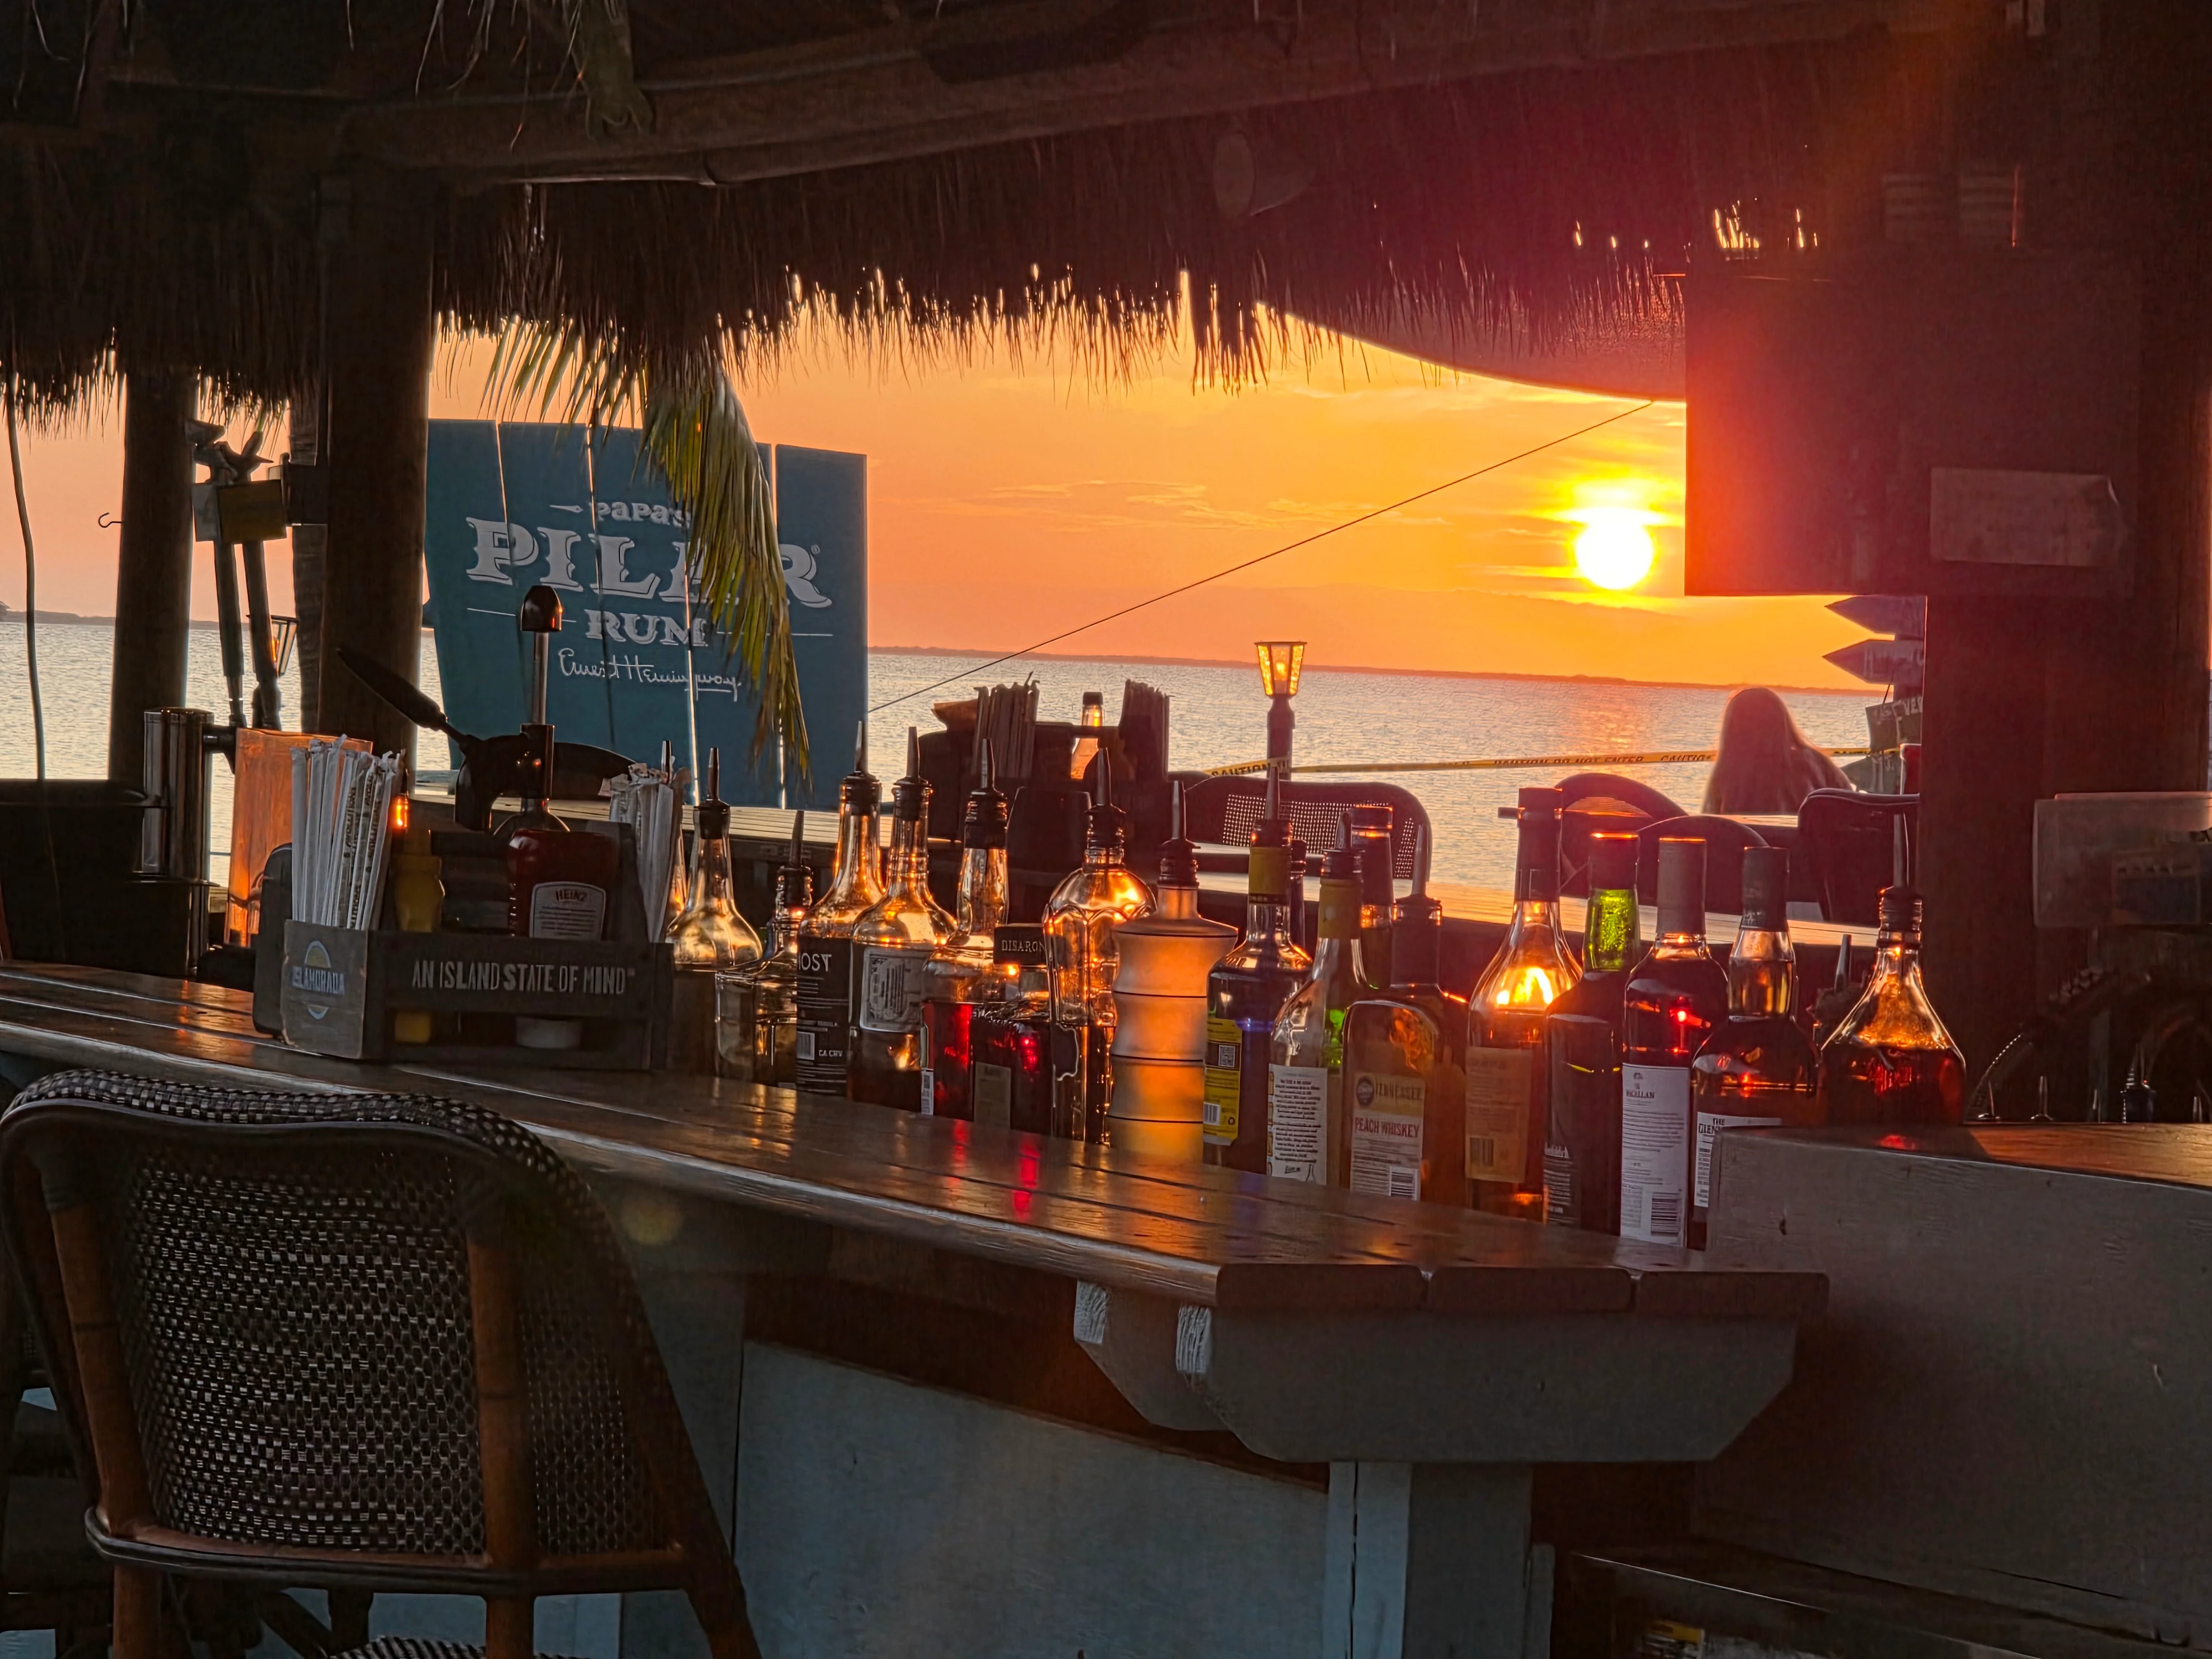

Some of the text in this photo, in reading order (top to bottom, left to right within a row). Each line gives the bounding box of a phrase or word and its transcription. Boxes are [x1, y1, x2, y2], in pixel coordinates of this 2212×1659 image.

[583, 609, 709, 648] RUM
[556, 889, 588, 904] HEINZ
[292, 966, 345, 995] ISLAMORADA
[412, 959, 435, 989] AN
[439, 961, 499, 990] ISLAND
[503, 963, 555, 993] STATE
[559, 966, 579, 993] OF
[1354, 1117, 1421, 1139] PEACH WHISKEY
